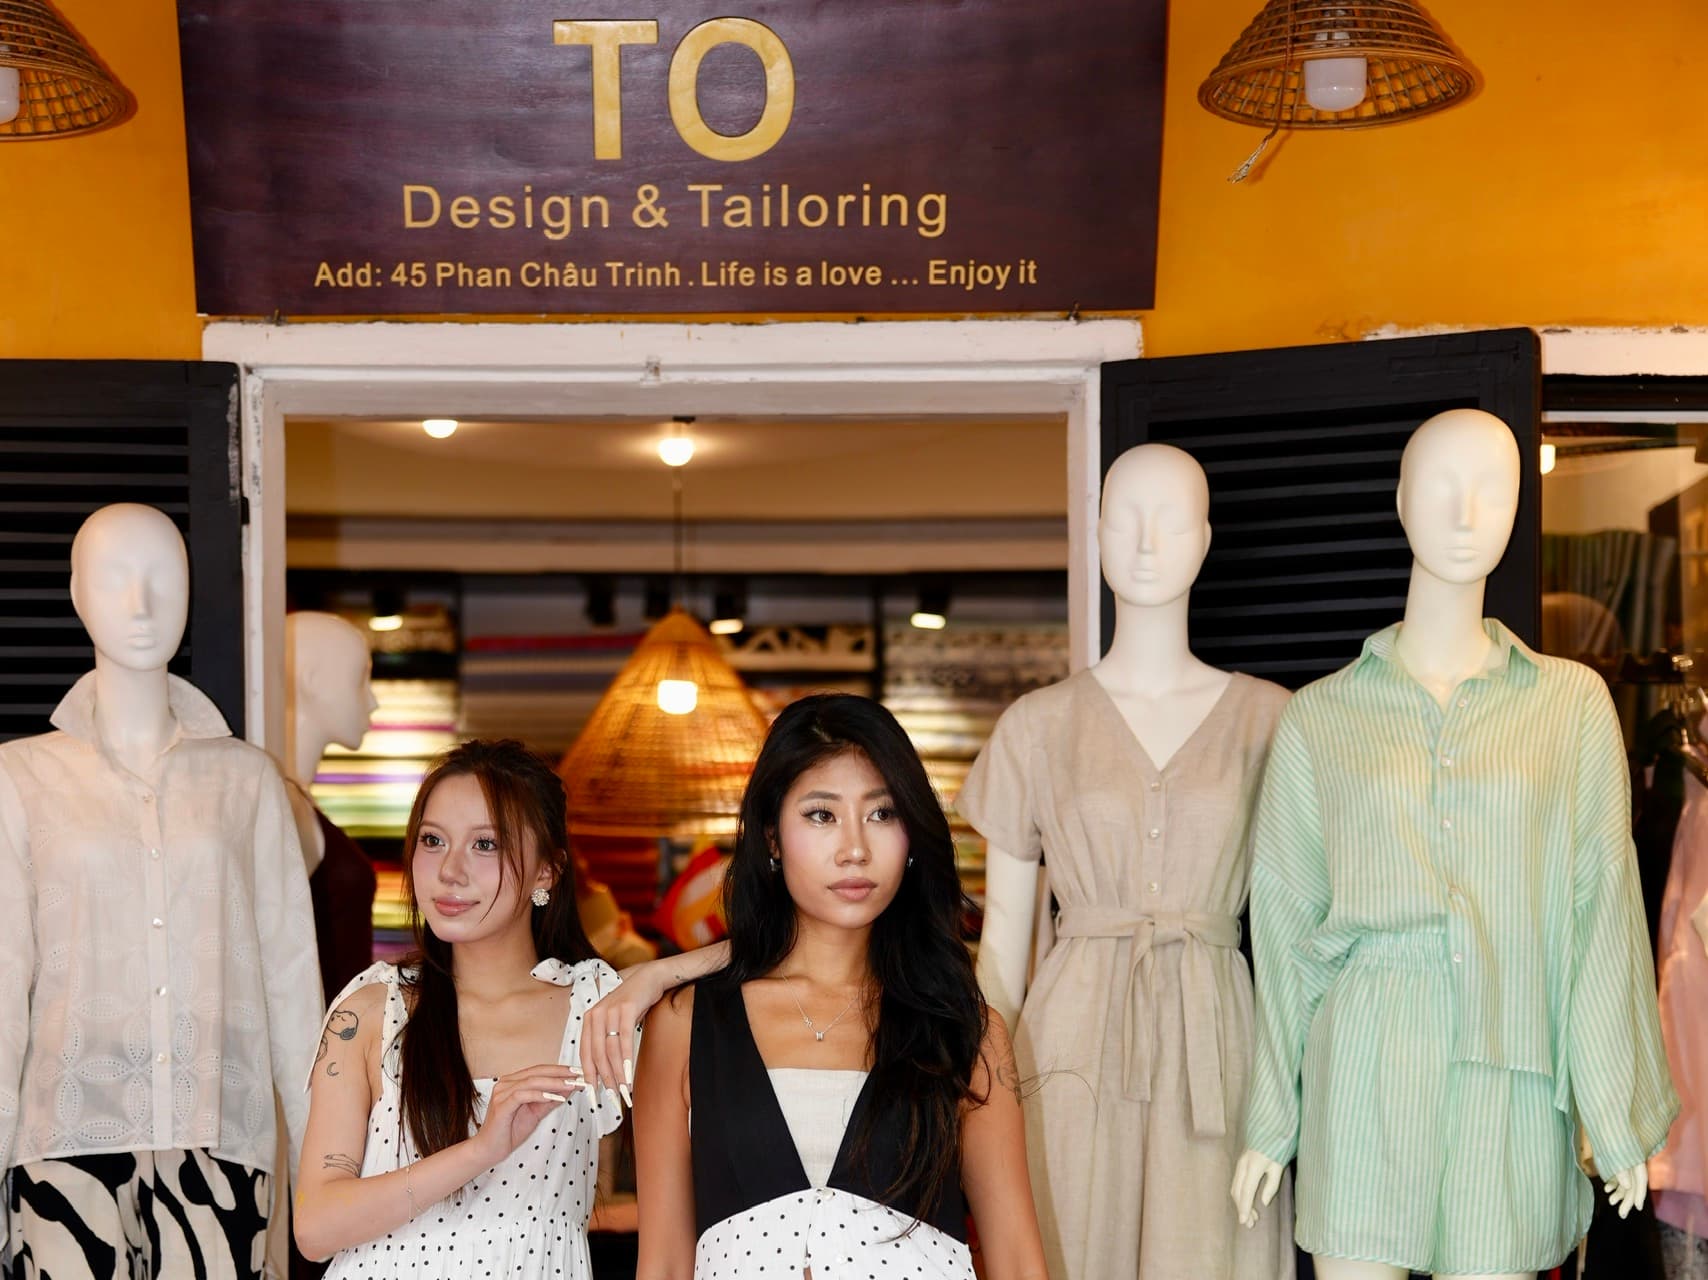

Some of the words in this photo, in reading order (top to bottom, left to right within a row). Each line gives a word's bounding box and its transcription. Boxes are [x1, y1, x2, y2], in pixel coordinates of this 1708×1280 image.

[552, 18, 796, 163] TO
[402, 184, 611, 241] Design
[630, 183, 670, 229] &
[687, 183, 947, 238] Tailoring
[314, 261, 382, 288] Add:
[390, 262, 428, 288] 45
[435, 261, 512, 288] Phan
[519, 261, 598, 288] Châu
[604, 261, 681, 288] Trinh
[701, 261, 756, 287] Life
[763, 261, 788, 287] is
[795, 266, 813, 287] a
[821, 260, 882, 287] love
[928, 259, 1012, 291] Enjoy
[1019, 260, 1037, 285] it
